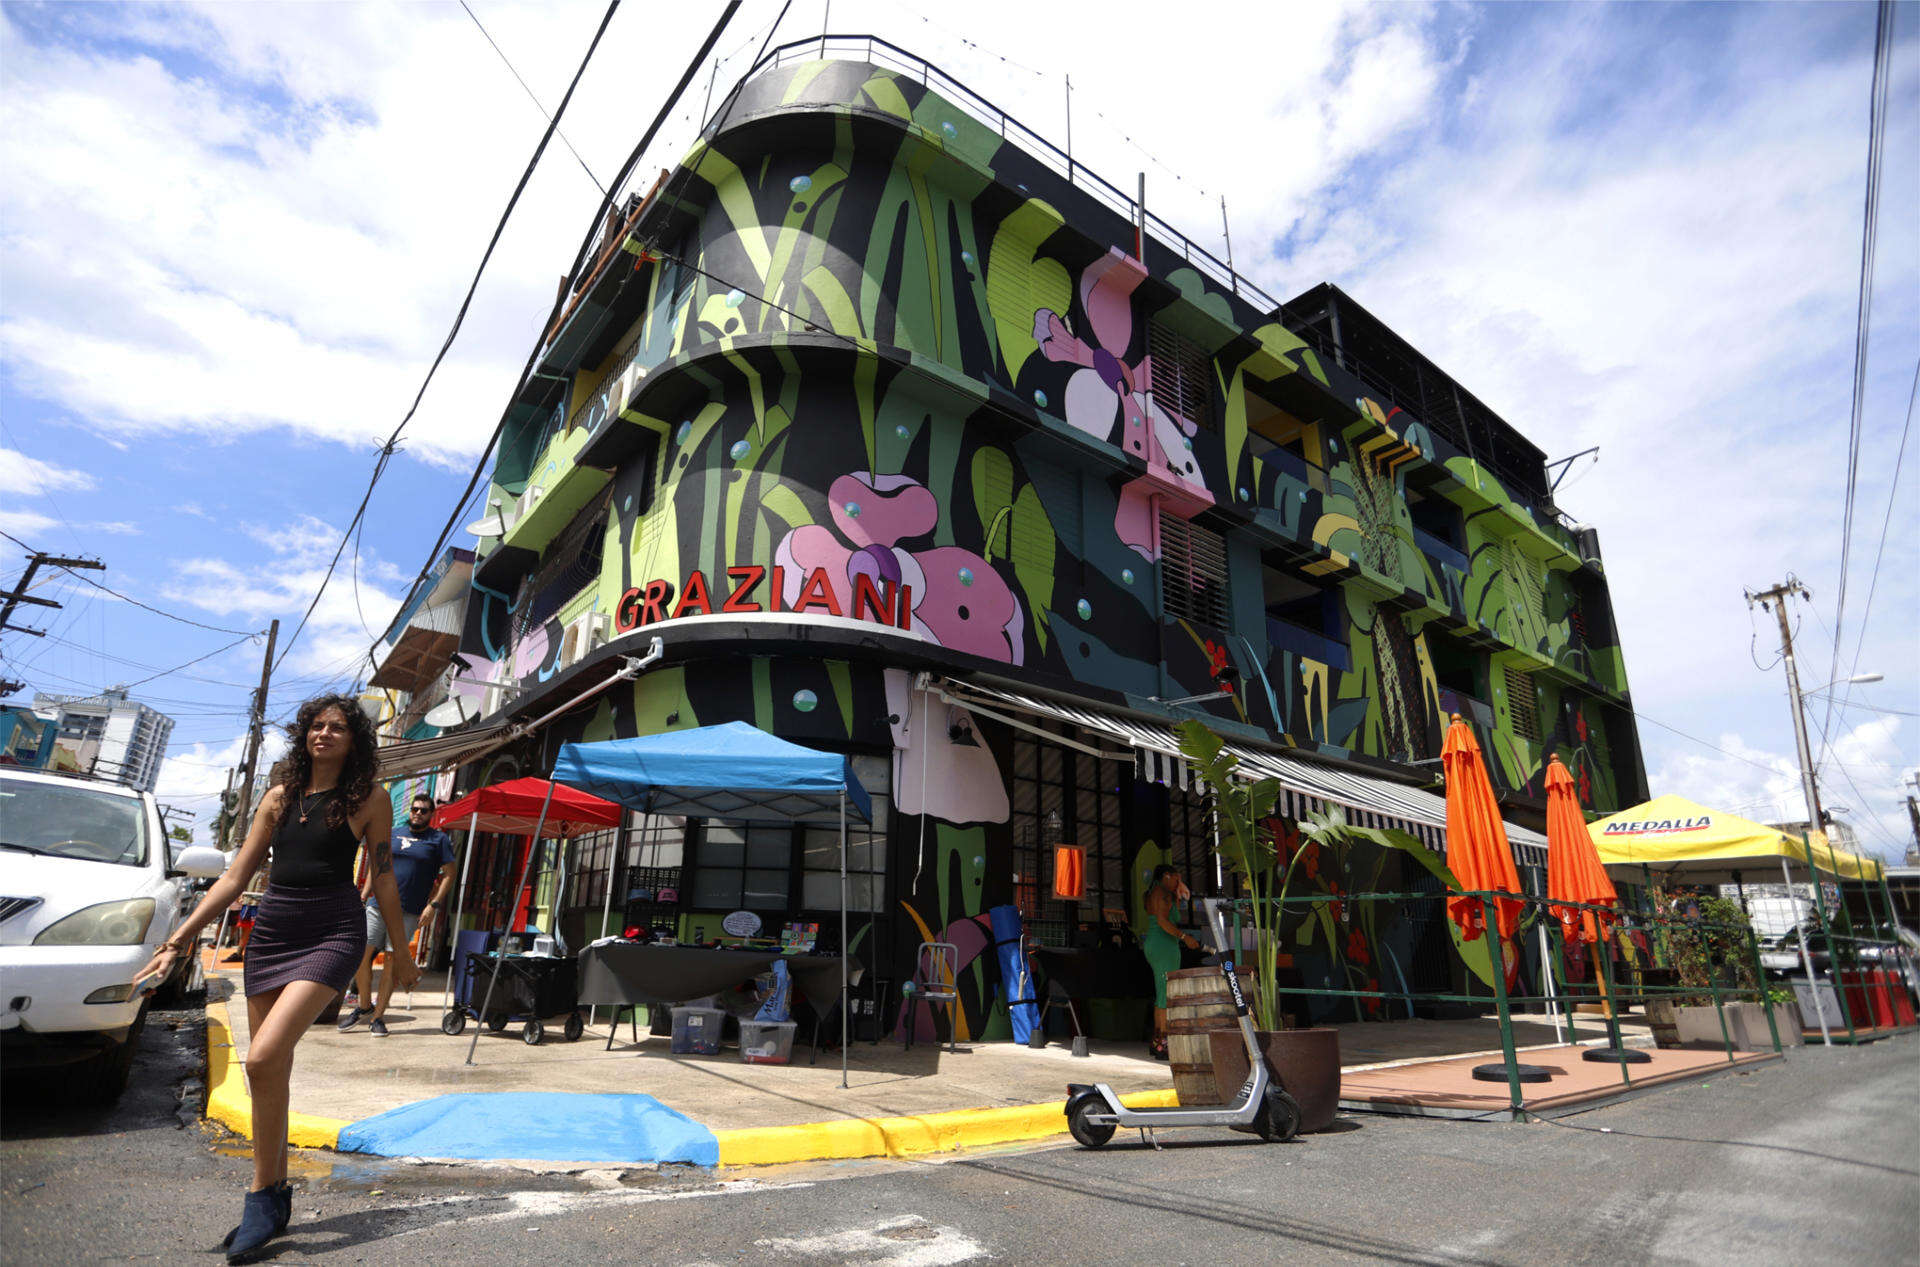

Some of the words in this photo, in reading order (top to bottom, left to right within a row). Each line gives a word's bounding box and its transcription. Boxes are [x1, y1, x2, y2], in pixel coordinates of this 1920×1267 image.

[615, 565, 912, 633] GRAZIANI
[1606, 816, 1711, 832] MEDALLA
[1228, 972, 1245, 1007] skootel
